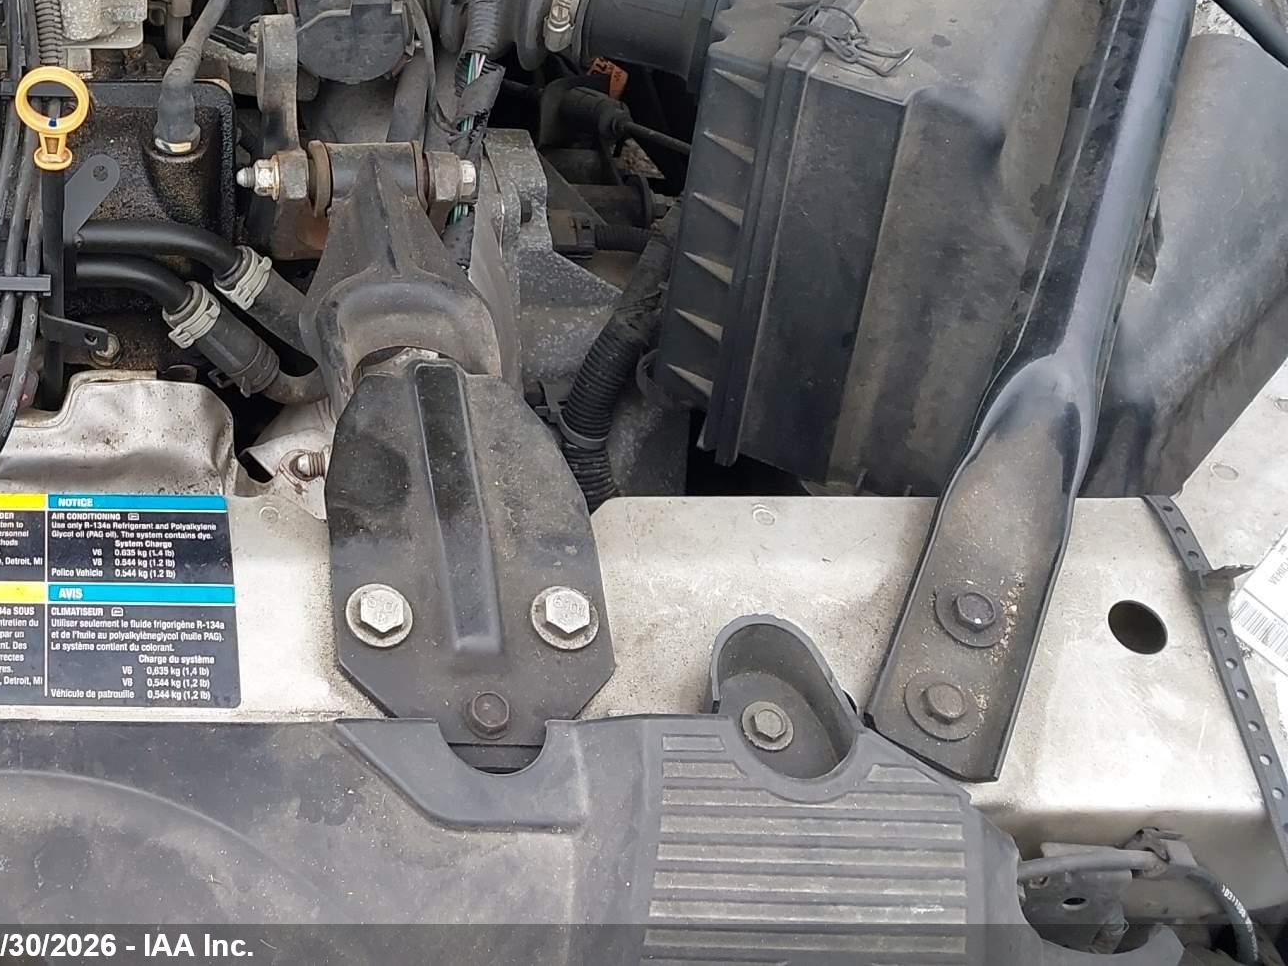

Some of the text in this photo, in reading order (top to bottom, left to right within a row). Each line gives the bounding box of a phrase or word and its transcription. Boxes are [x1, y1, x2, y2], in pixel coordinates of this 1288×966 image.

[59, 498, 93, 506] NOTICE
[138, 559, 147, 567] kg
[59, 589, 83, 599] AVIS
[14, 607, 34, 615] SOUS
[51, 607, 103, 616] CLIMATISEUR
[51, 619, 77, 627] Utiliser
[80, 620, 119, 628] seulement
[121, 620, 128, 628] le
[131, 620, 151, 628] fluide
[154, 620, 194, 630] frigorigène
[181, 632, 201, 641] (huile
[13, 641, 27, 650] Des
[63, 643, 94, 652] système
[96, 643, 126, 651] contient
[130, 643, 139, 651] du
[139, 655, 214, 664] Charge du système
[171, 667, 209, 676] kg (1,4 lb)
[4, 676, 31, 685] Detroit,
[33, 676, 42, 684] MI
[171, 678, 181, 688] kg
[183, 678, 198, 687] (1,2
[200, 679, 210, 688] lb)
[86, 690, 95, 698] de
[172, 691, 181, 700] kg
[183, 691, 198, 700] (1,2
[201, 691, 210, 700] lb)
